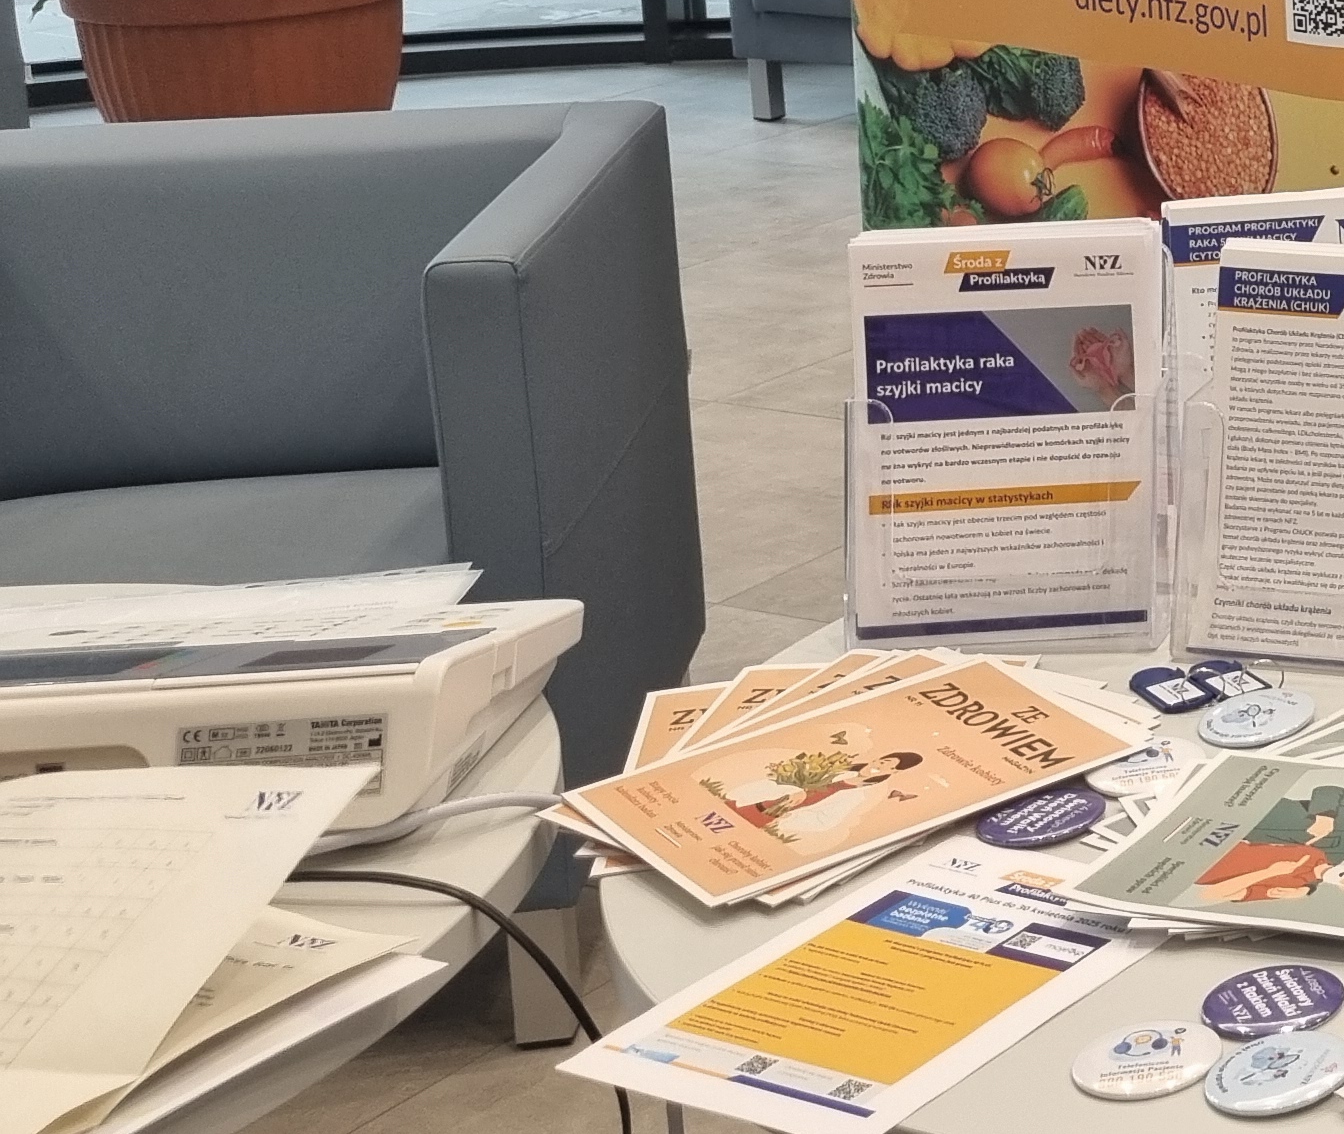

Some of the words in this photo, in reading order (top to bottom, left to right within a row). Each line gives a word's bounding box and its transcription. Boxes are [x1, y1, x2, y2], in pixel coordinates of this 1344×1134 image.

[1188, 224, 1242, 236] PROGRAM
[1244, 218, 1319, 232] PROFILAKTYKI
[1189, 238, 1218, 248] RAKA
[862, 262, 913, 272] Ministerstwo
[952, 254, 992, 270] Środa
[995, 257, 1003, 267] z
[1083, 254, 1123, 271] NFZ
[862, 271, 895, 281] Zdrowia
[969, 272, 1046, 286] Profilaktyką
[1234, 271, 1317, 286] PROFILAKTYKA
[1233, 283, 1281, 297] CHORÓB
[1282, 287, 1331, 300] UKŁADU
[1233, 295, 1289, 311] KRĄŻENIA
[1289, 300, 1330, 314] (CHUK)
[876, 354, 975, 375] Profilaktyka
[979, 354, 1015, 368] raka
[876, 379, 921, 400] szyjki
[925, 378, 983, 396] macicy
[917, 431, 942, 441] macicy
[904, 497, 934, 509] szyjki
[936, 496, 973, 509] macicy
[975, 495, 986, 504] w
[987, 490, 1054, 505] statystykach
[311, 720, 339, 729] TANITA
[341, 718, 383, 727] Corporation
[1011, 705, 1051, 725] ZE
[918, 682, 1075, 769] ZDROWIEM
[936, 745, 974, 768] Zdrowie
[969, 764, 1005, 786] kobiety
[699, 810, 735, 834] NFZ
[1252, 970, 1278, 995] Dzień
[1271, 991, 1303, 1019] Walki
[1275, 968, 1315, 1009] Światowy
[1236, 981, 1244, 989] z
[1241, 985, 1273, 1019] Rakiem
[1230, 1003, 1255, 1024] NFZ
